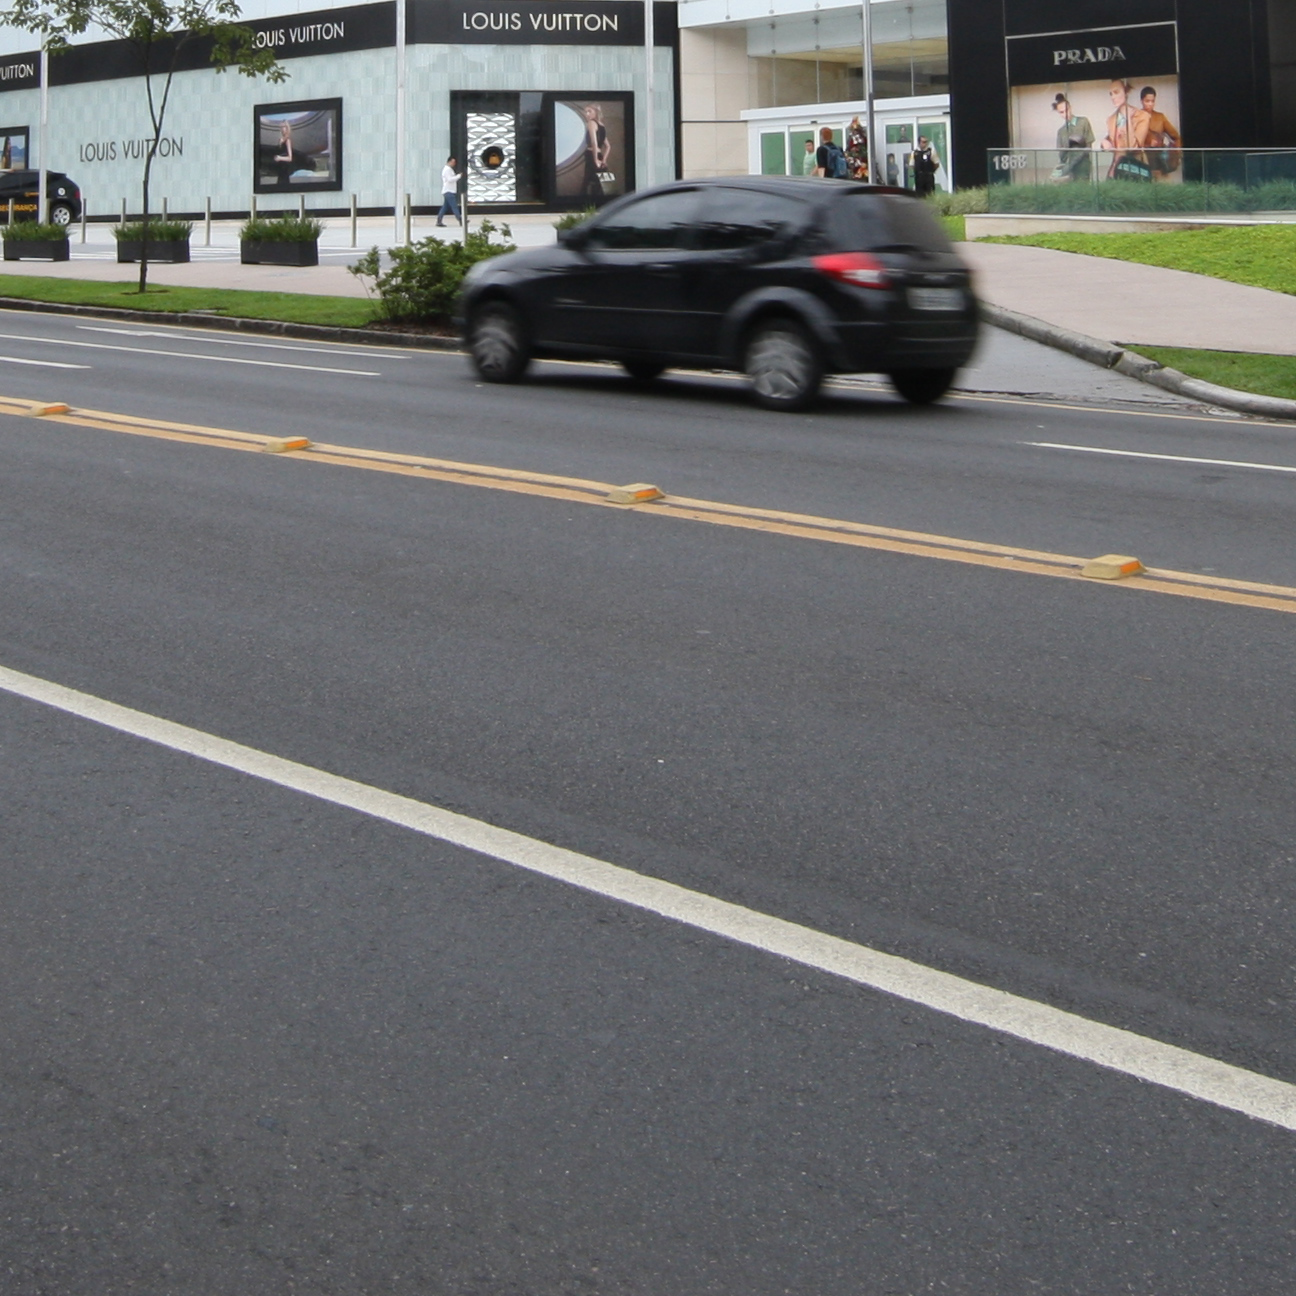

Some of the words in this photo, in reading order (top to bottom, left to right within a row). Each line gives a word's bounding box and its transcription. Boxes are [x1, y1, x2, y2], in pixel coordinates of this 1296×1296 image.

[463, 12, 522, 31] LOUIS
[529, 13, 618, 32] VUITTON
[289, 22, 344, 44] VUITTON
[1053, 46, 1126, 65] PRADA
[80, 141, 117, 162] LOUIS
